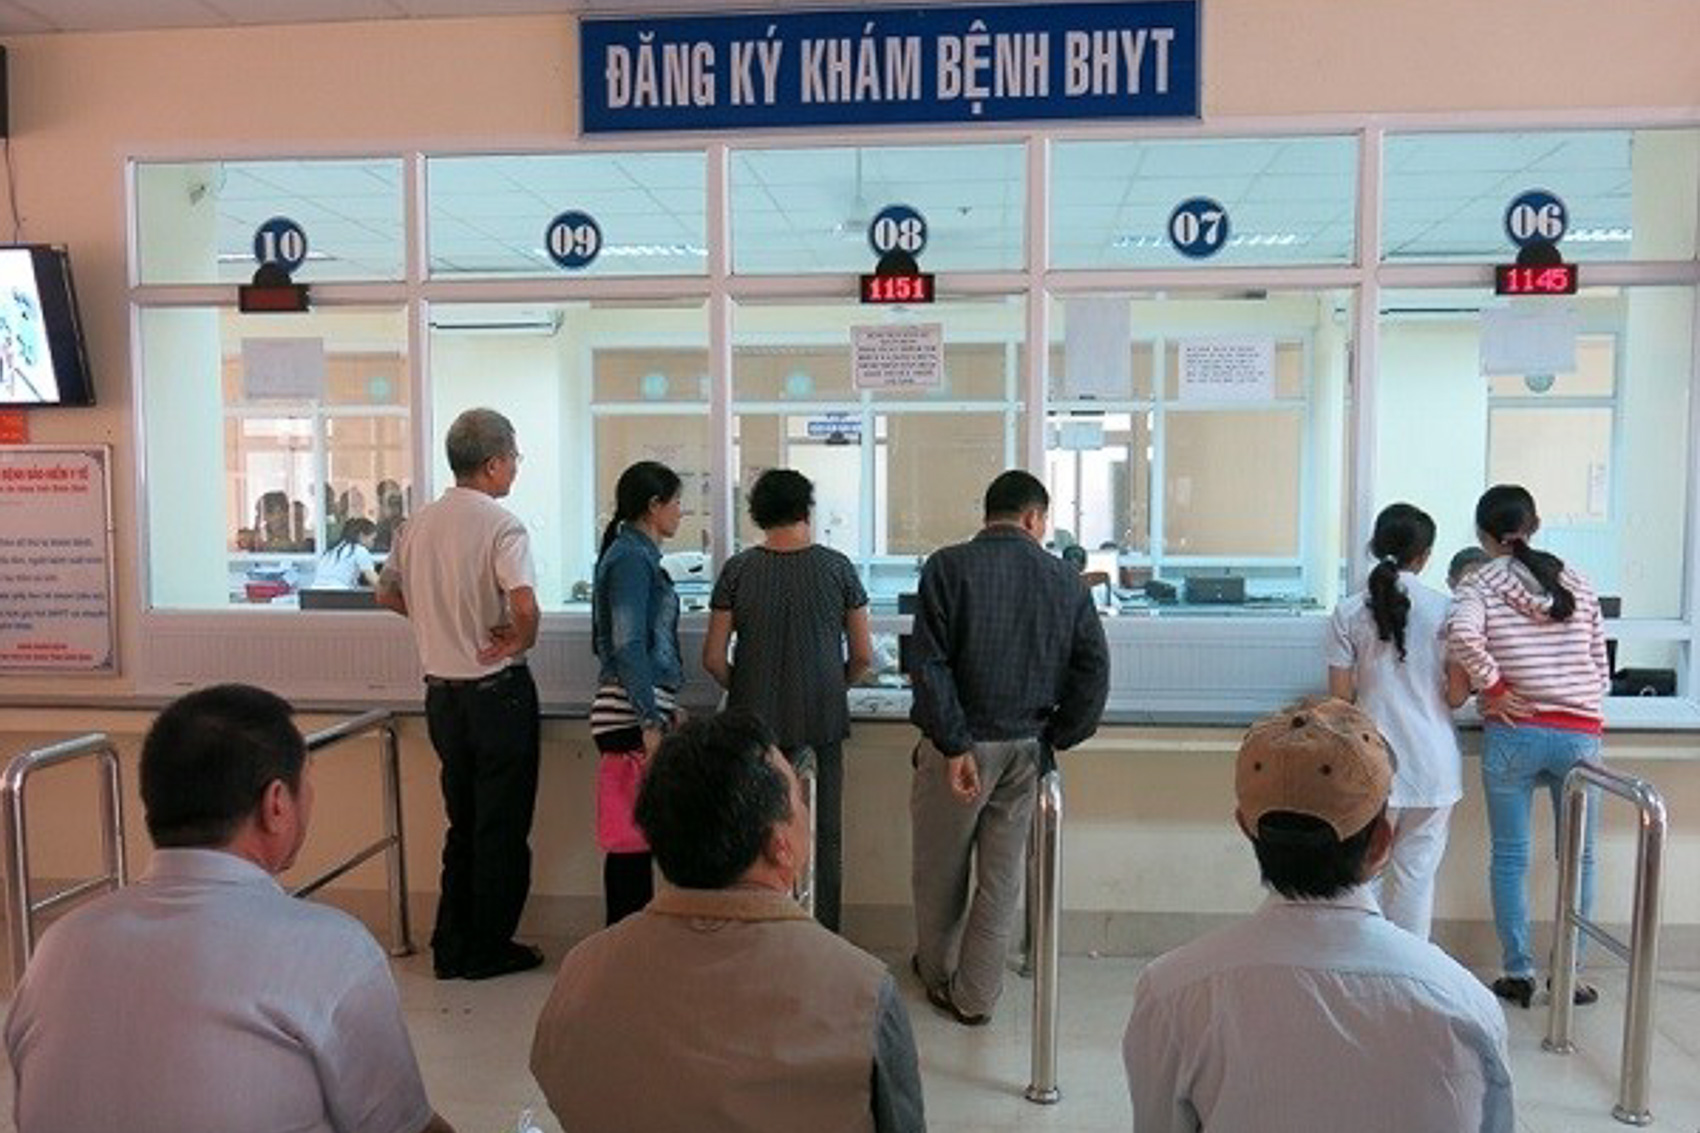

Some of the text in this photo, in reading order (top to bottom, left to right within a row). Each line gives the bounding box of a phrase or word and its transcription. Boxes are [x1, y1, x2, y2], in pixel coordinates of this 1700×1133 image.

[604, 20, 1175, 115] ĐĂNG KÝ KHÁM BỆNH BHYT
[873, 216, 923, 252] 08
[1173, 211, 1224, 246] 07
[1509, 203, 1563, 239] 06
[261, 229, 304, 262] 10
[551, 223, 597, 257] 09
[869, 276, 926, 299] 1151
[1508, 267, 1569, 292] 1145
